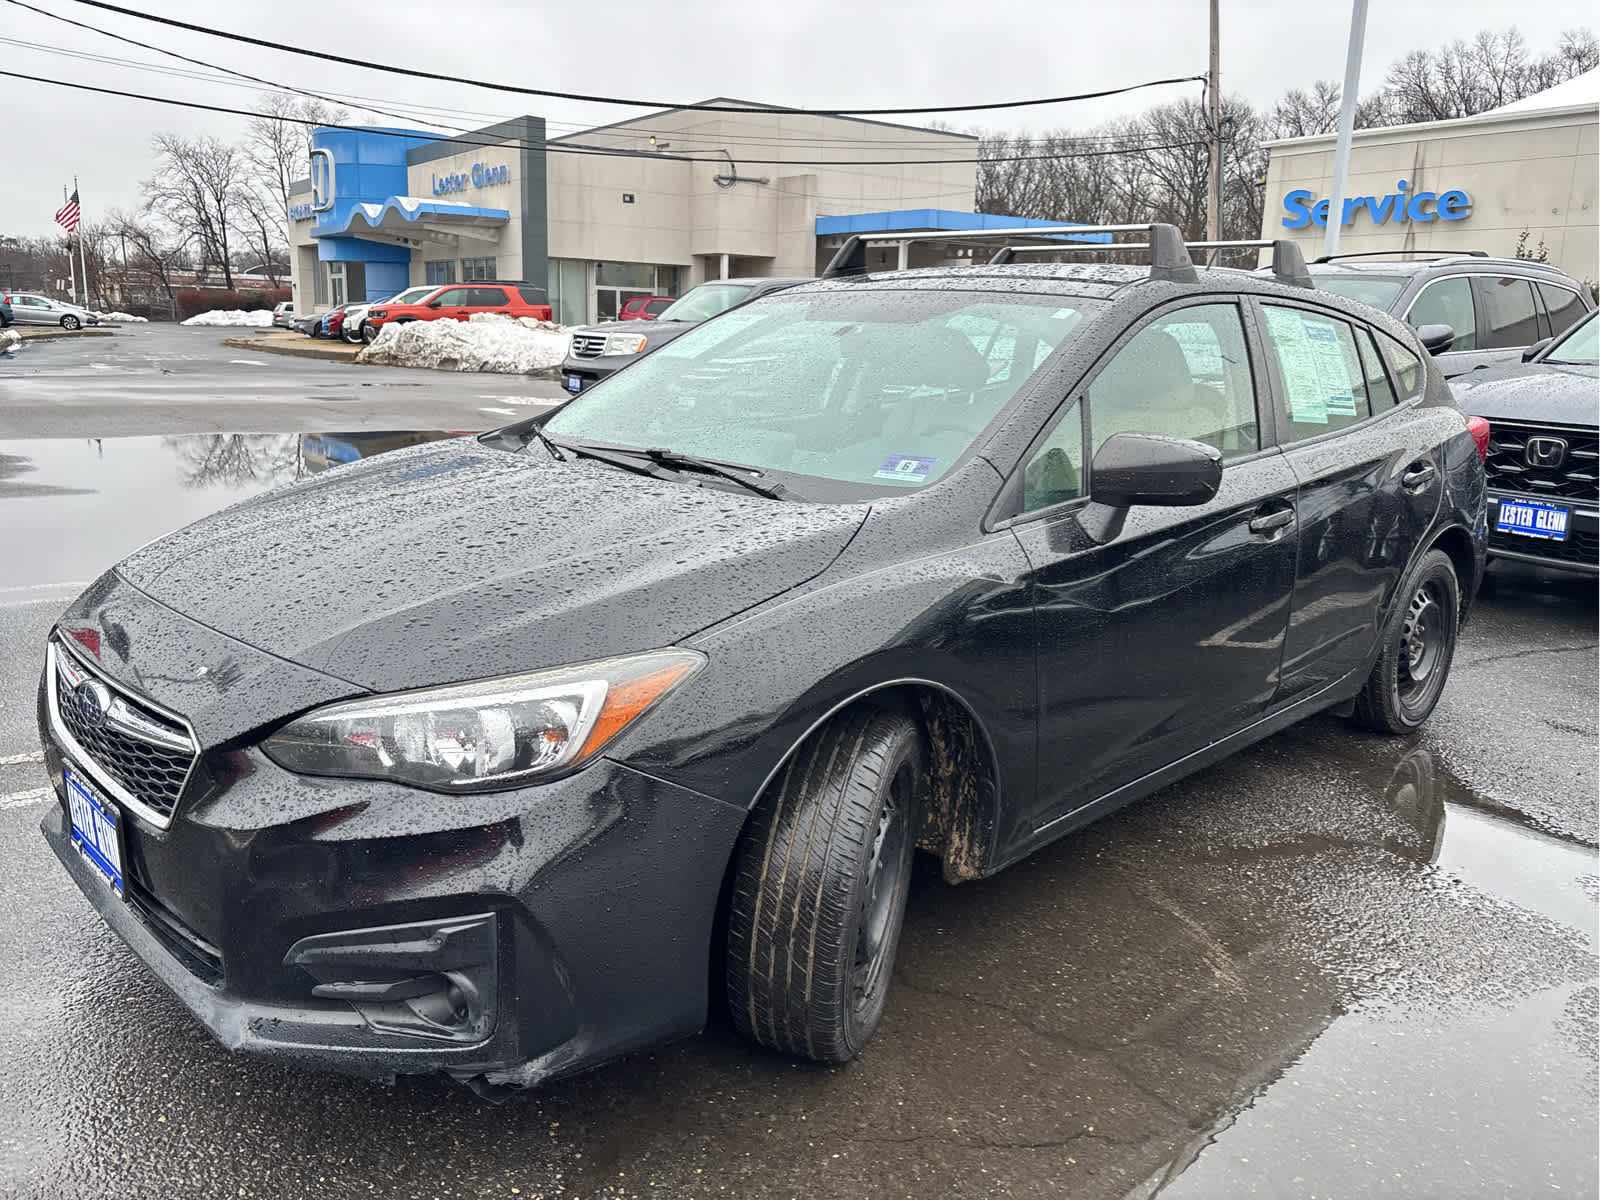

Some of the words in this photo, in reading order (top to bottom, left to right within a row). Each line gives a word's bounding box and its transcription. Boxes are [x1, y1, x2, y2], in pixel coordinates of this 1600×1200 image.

[432, 172, 467, 195] Lester
[471, 162, 507, 187] Glenn
[1281, 179, 1470, 229] Service
[1499, 504, 1533, 527] LESTER
[1535, 509, 1567, 532] GLENN
